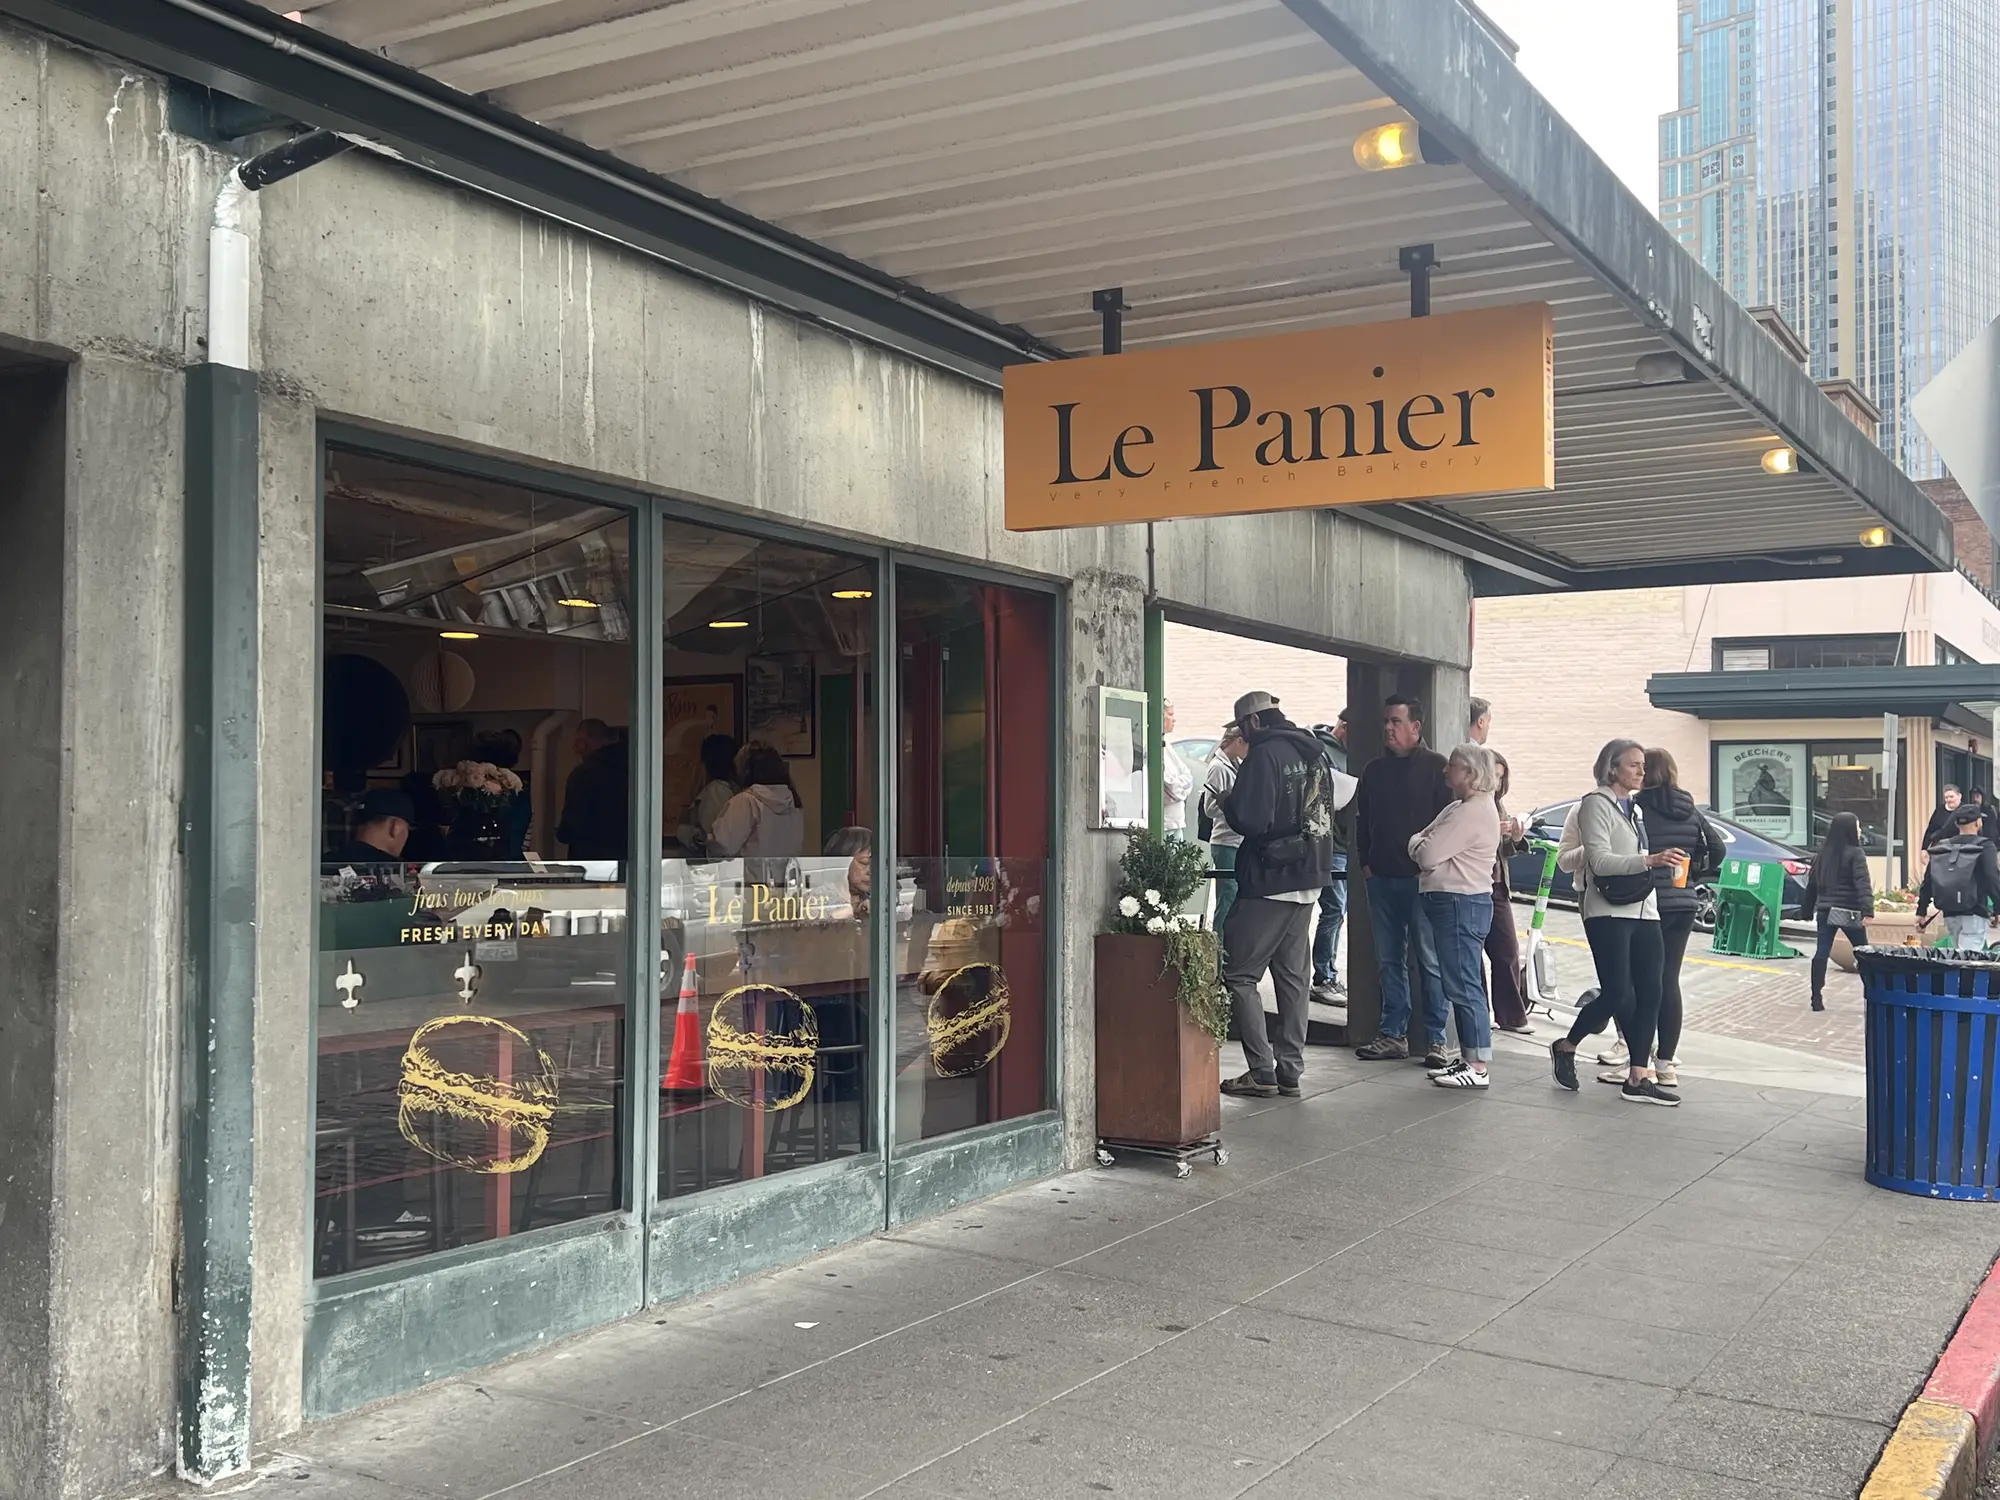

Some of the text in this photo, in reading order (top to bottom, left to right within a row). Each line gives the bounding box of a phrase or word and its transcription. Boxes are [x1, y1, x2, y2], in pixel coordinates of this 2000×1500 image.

[1048, 366, 1495, 485] Le Panier
[1049, 454, 1482, 502] Very French Bakery
[1734, 748, 1792, 762] BEECHER'S
[408, 885, 449, 916] frais
[453, 888, 484, 907] tous
[488, 884, 504, 906] les
[946, 876, 995, 898] depuis 1983
[707, 884, 830, 924] Le Panier
[947, 904, 994, 916] SINCE 1983
[400, 920, 551, 943] FRESH EVERY DAY
